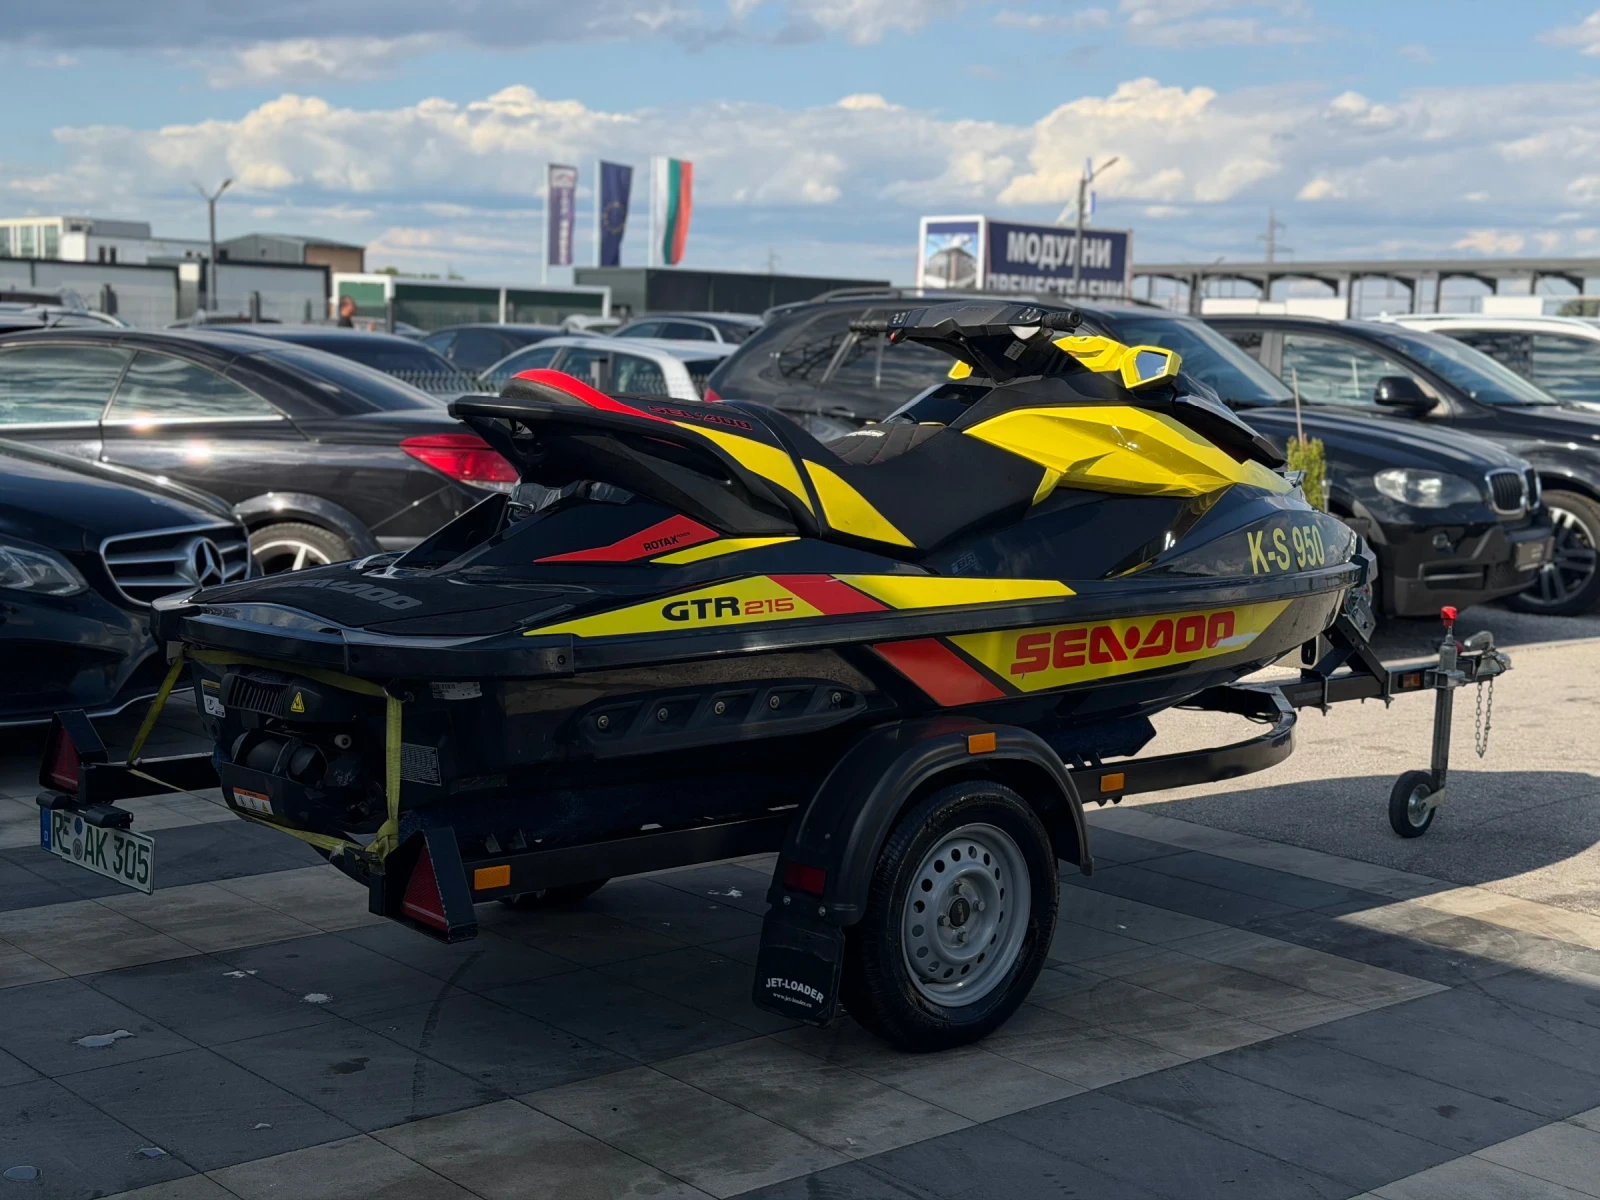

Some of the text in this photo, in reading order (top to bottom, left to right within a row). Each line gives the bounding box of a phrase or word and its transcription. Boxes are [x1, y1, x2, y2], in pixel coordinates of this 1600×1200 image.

[643, 535, 679, 551] ROTAX
[1247, 525, 1324, 574] K-S 950
[662, 597, 795, 621] GTR 215
[84, 825, 109, 870] AK
[113, 835, 150, 884] 305
[766, 978, 824, 1004] JET-LOADER
